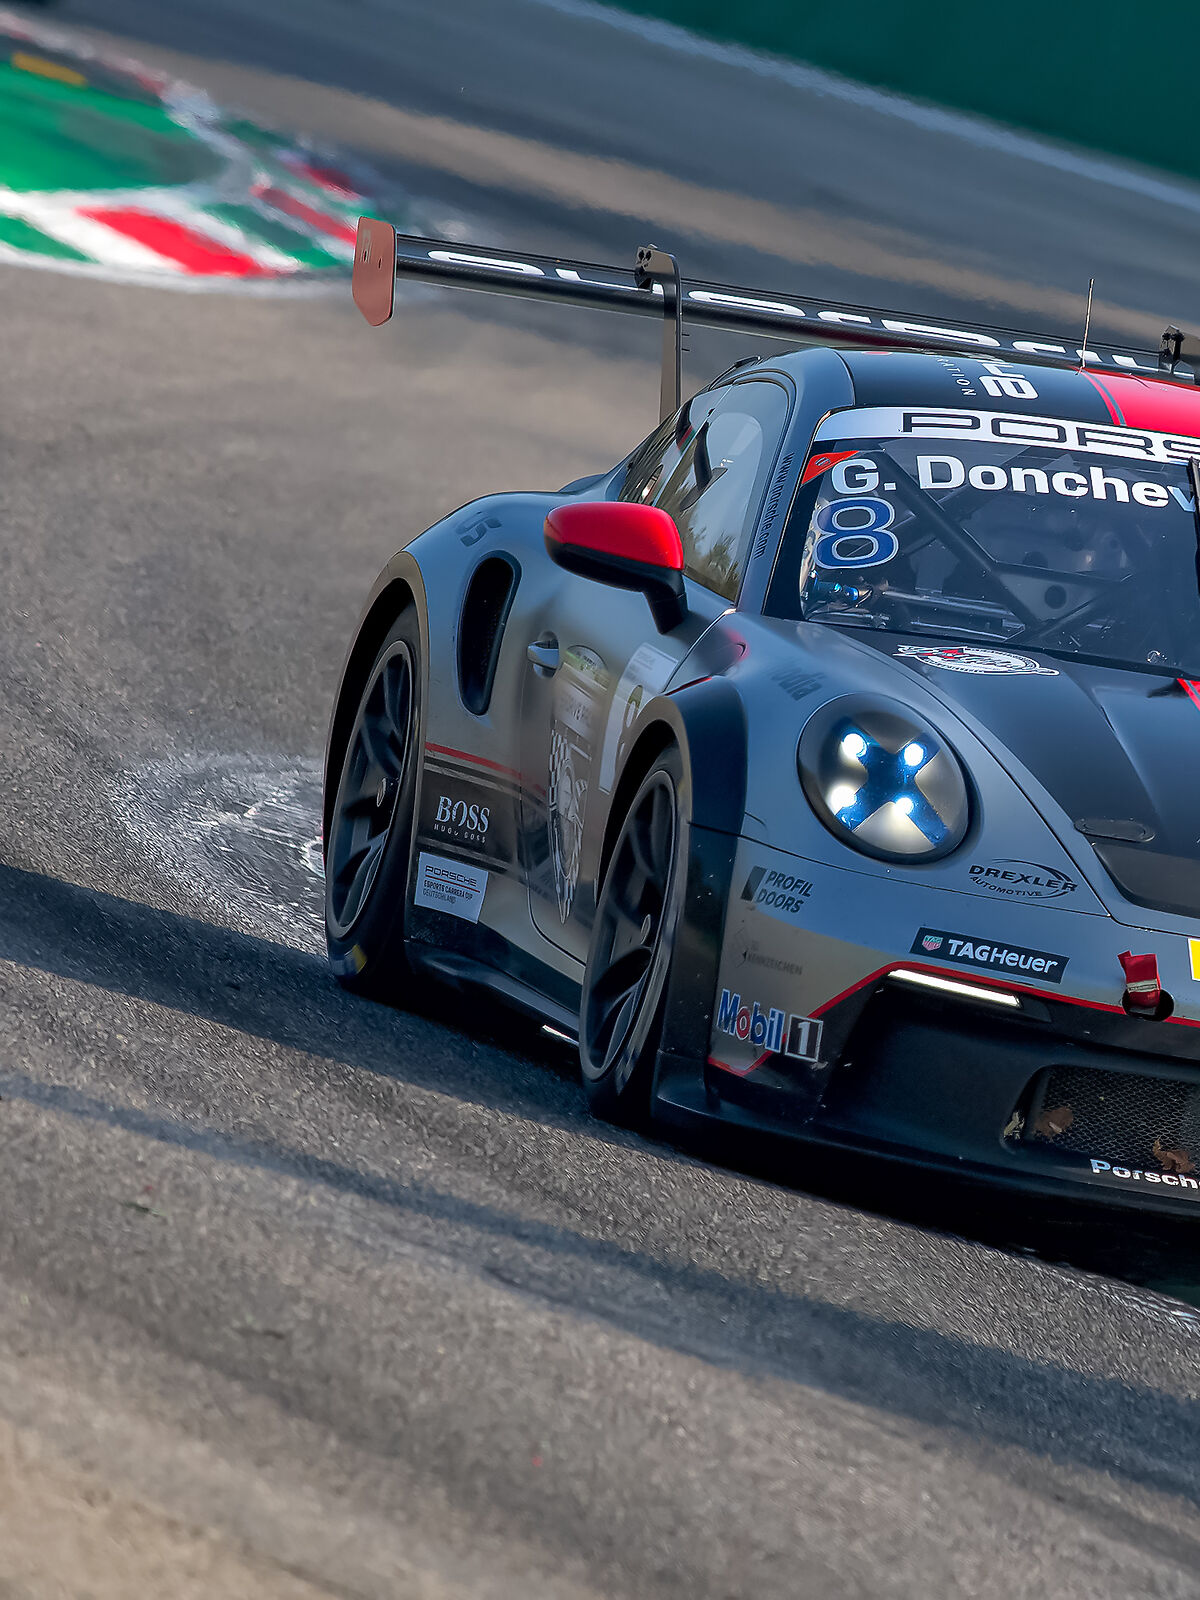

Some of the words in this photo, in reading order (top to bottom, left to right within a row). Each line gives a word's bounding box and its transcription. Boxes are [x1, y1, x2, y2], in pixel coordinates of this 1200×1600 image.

[831, 458, 897, 504] G.
[753, 452, 795, 560] www.porsche.com
[813, 496, 900, 570] 8
[435, 796, 490, 833] BOSS
[434, 824, 459, 836] HUGO
[423, 879, 445, 893] ESPORTS
[445, 884, 465, 898] CARRERA
[465, 891, 474, 901] CUP
[425, 865, 477, 887] PORSCHE
[765, 870, 814, 898] PROFIL
[968, 864, 1078, 892] DREXLER
[970, 876, 1043, 897] AUTOMOTIVE
[422, 888, 457, 904] DEUTSCHLAND
[756, 888, 805, 913] DOORS
[716, 988, 786, 1054] Mobil
